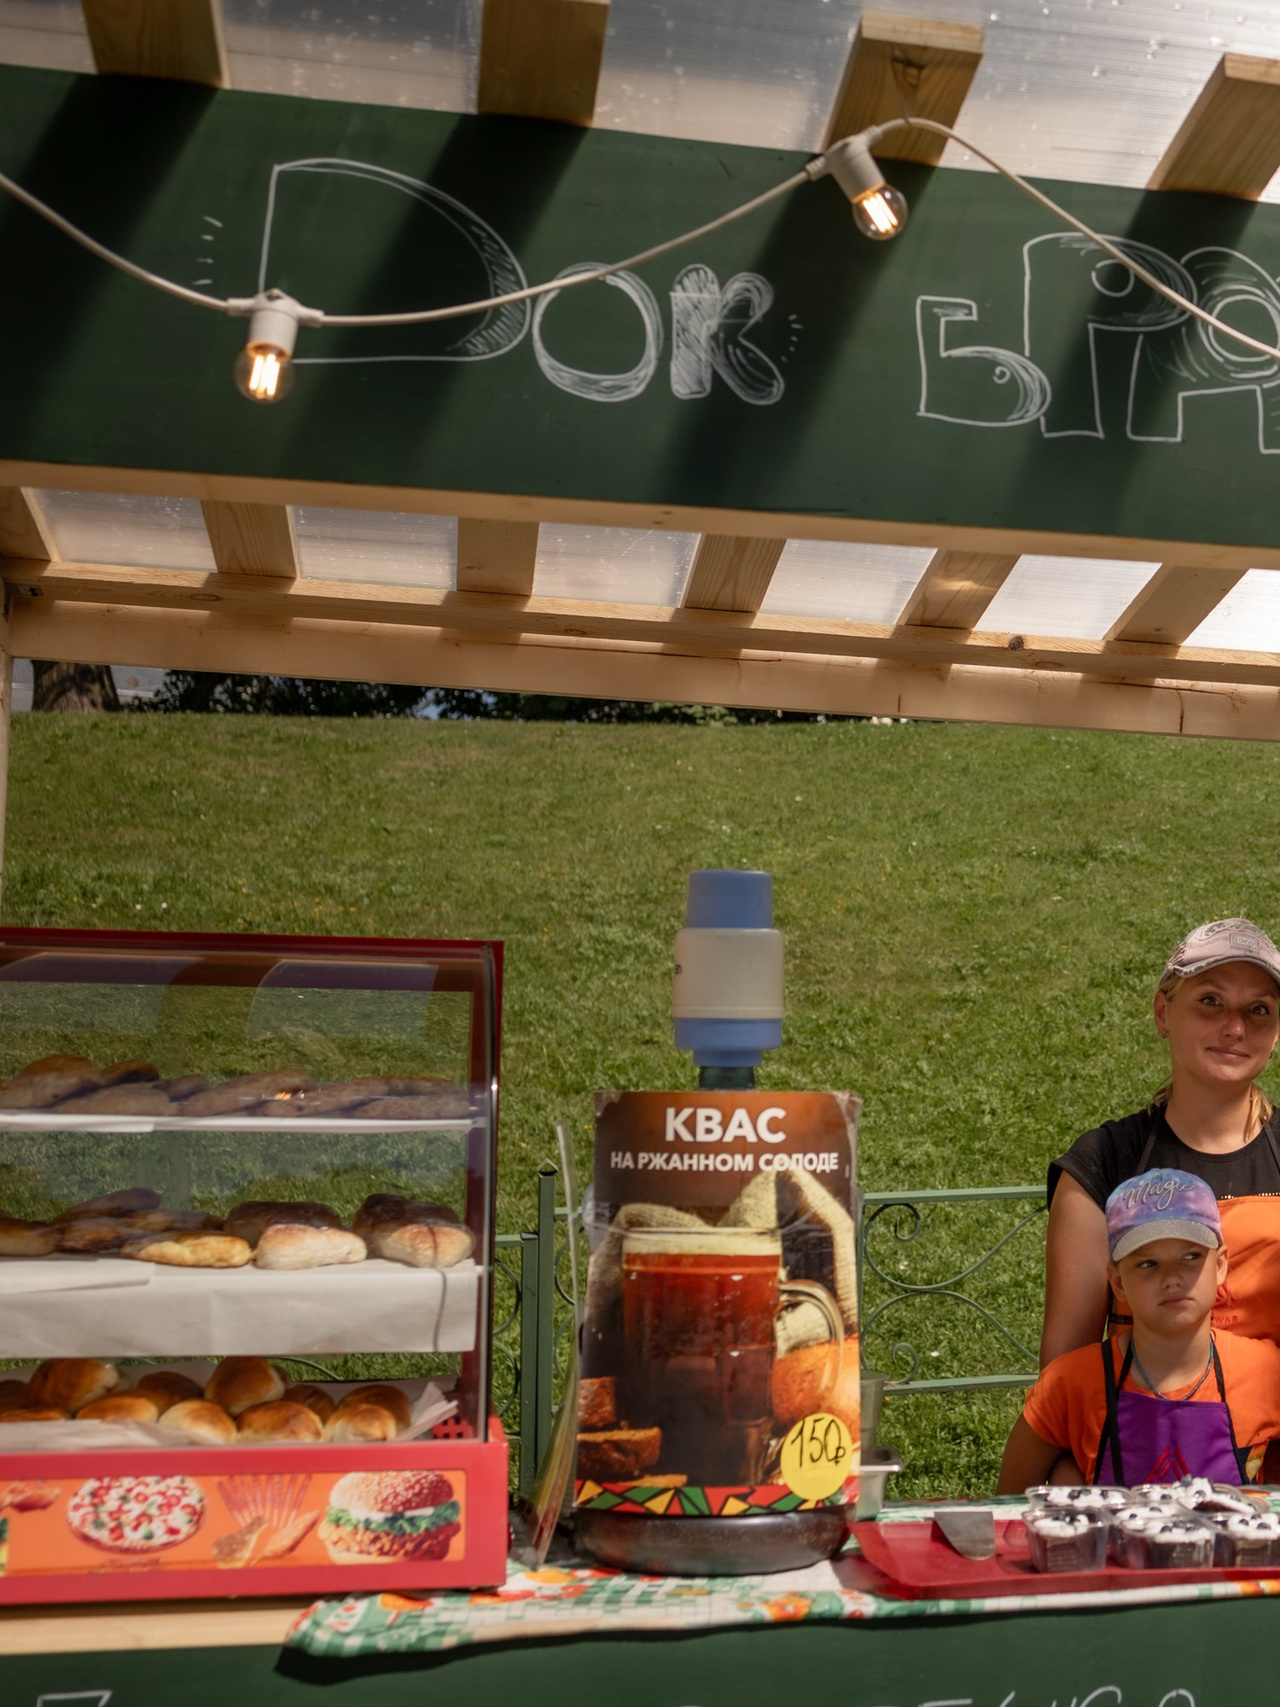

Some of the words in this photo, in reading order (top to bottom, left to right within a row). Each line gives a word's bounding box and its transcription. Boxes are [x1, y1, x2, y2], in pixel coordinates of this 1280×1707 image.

[665, 1107, 787, 1143] КВАС
[610, 1151, 635, 1169] НА
[637, 1152, 754, 1172] РЖАННОМ
[758, 1152, 839, 1173] СОЛОДЕ
[1123, 1179, 1195, 1211] Magic
